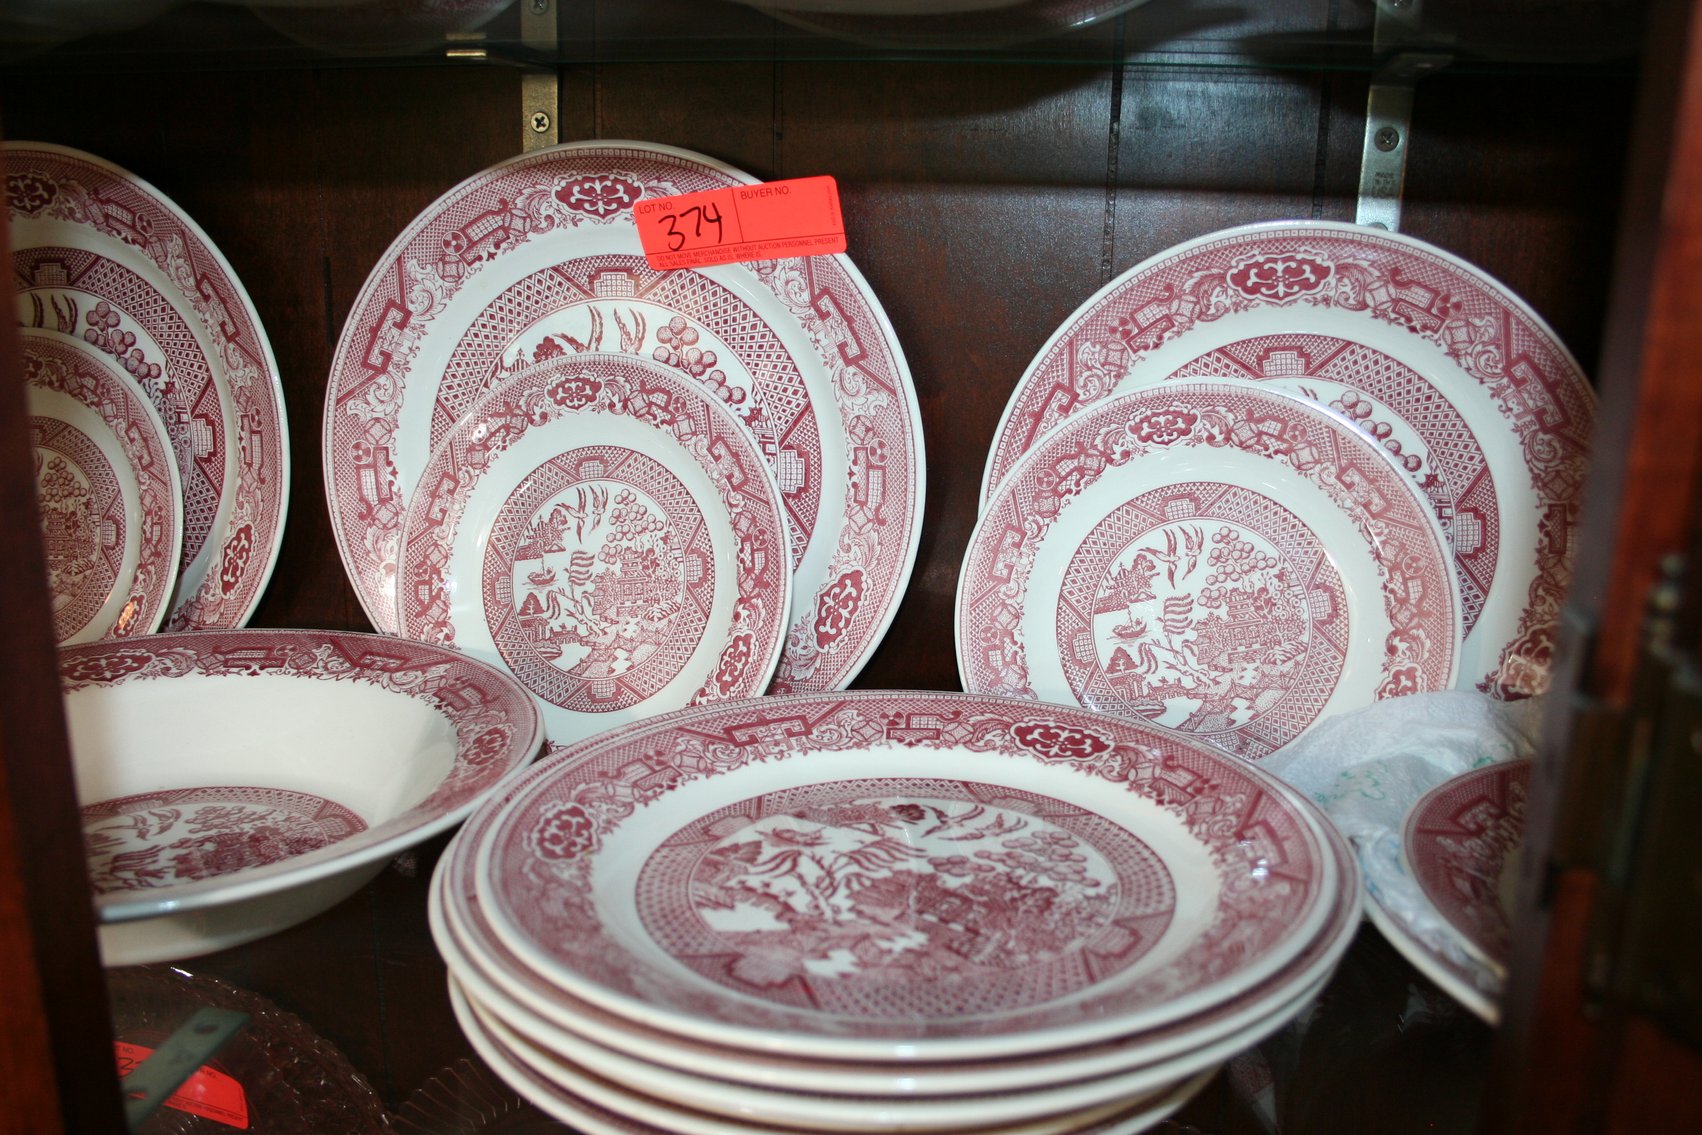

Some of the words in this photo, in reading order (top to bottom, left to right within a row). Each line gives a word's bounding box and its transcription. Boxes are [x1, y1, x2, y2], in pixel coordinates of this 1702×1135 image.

[740, 187, 773, 199] BUYER
[774, 186, 791, 195] NO.
[639, 204, 656, 214] LOT
[658, 202, 723, 251] 374
[693, 249, 731, 258] MERCHANDISE
[733, 244, 757, 252] WITHOUT
[782, 239, 814, 248] PERSONNEL
[736, 251, 754, 260] WHERE
